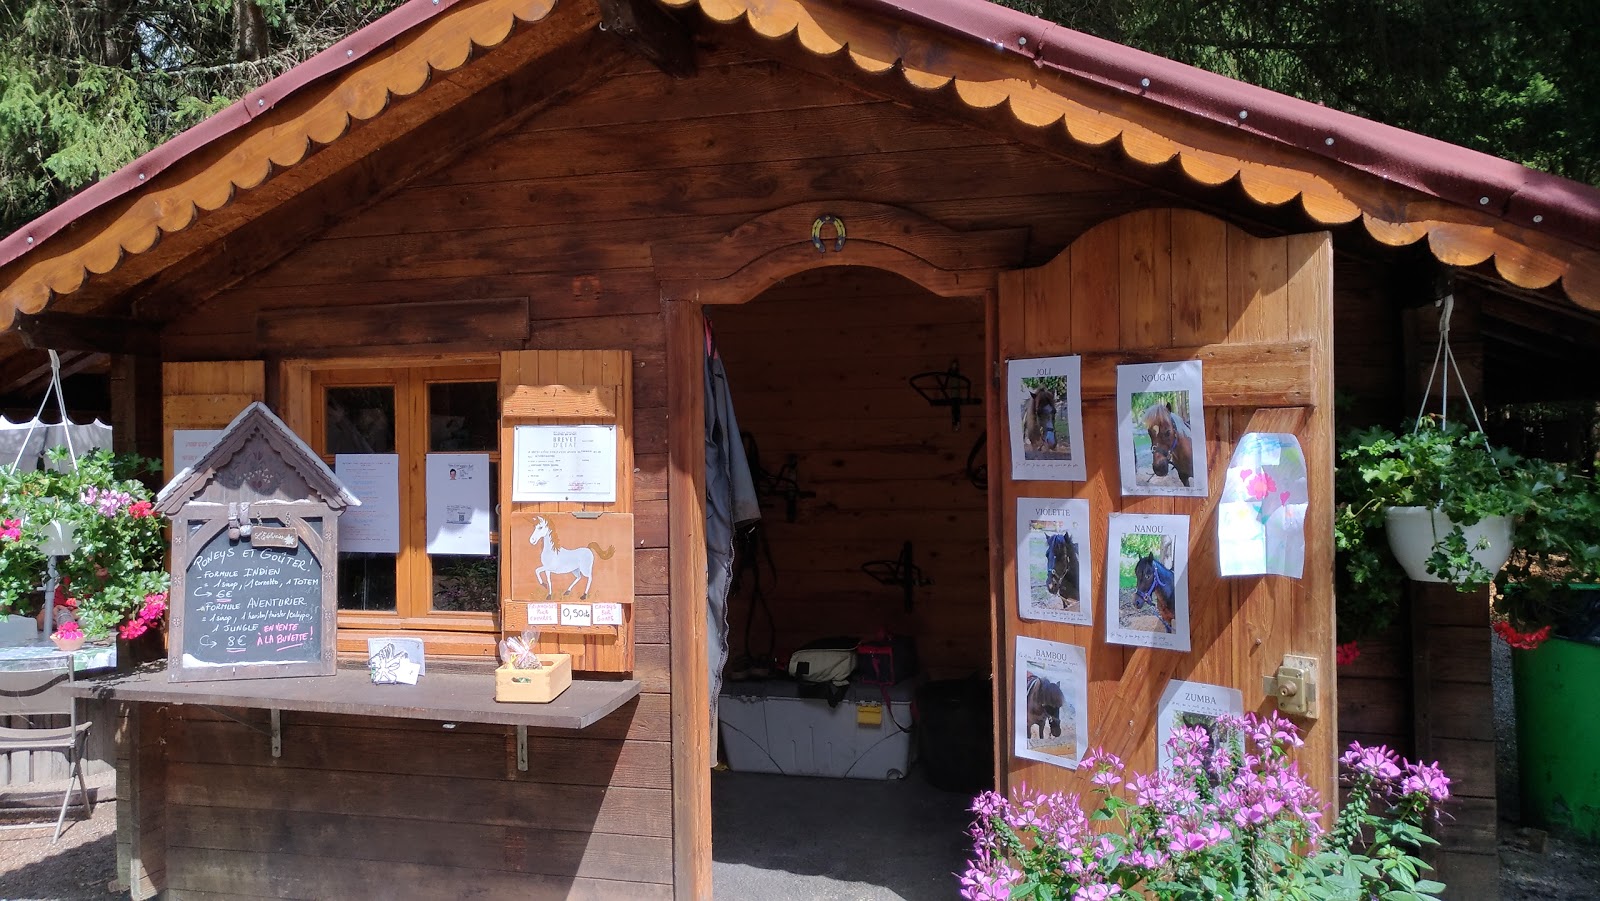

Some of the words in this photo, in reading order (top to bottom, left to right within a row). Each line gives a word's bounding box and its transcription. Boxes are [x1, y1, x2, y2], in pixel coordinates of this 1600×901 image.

[1036, 368, 1052, 376] JOLI
[1141, 373, 1177, 383] NOUGAT
[1035, 508, 1071, 517] VIOLETTE
[1134, 524, 1164, 533] NANOU
[242, 548, 254, 558] ET
[204, 570, 239, 579] FORMULE
[243, 565, 281, 577] INDIEN
[292, 578, 319, 586] TOTEM
[215, 590, 233, 598] 6€
[205, 602, 241, 612] FORMULE
[246, 597, 308, 609] AVENTURIER
[222, 624, 259, 632] JUNGLE
[275, 623, 299, 632] VENTE
[226, 635, 247, 647] 8€
[264, 634, 273, 644] LA
[1035, 649, 1067, 661] BAMBOU
[1185, 692, 1217, 705] ZUMBA
